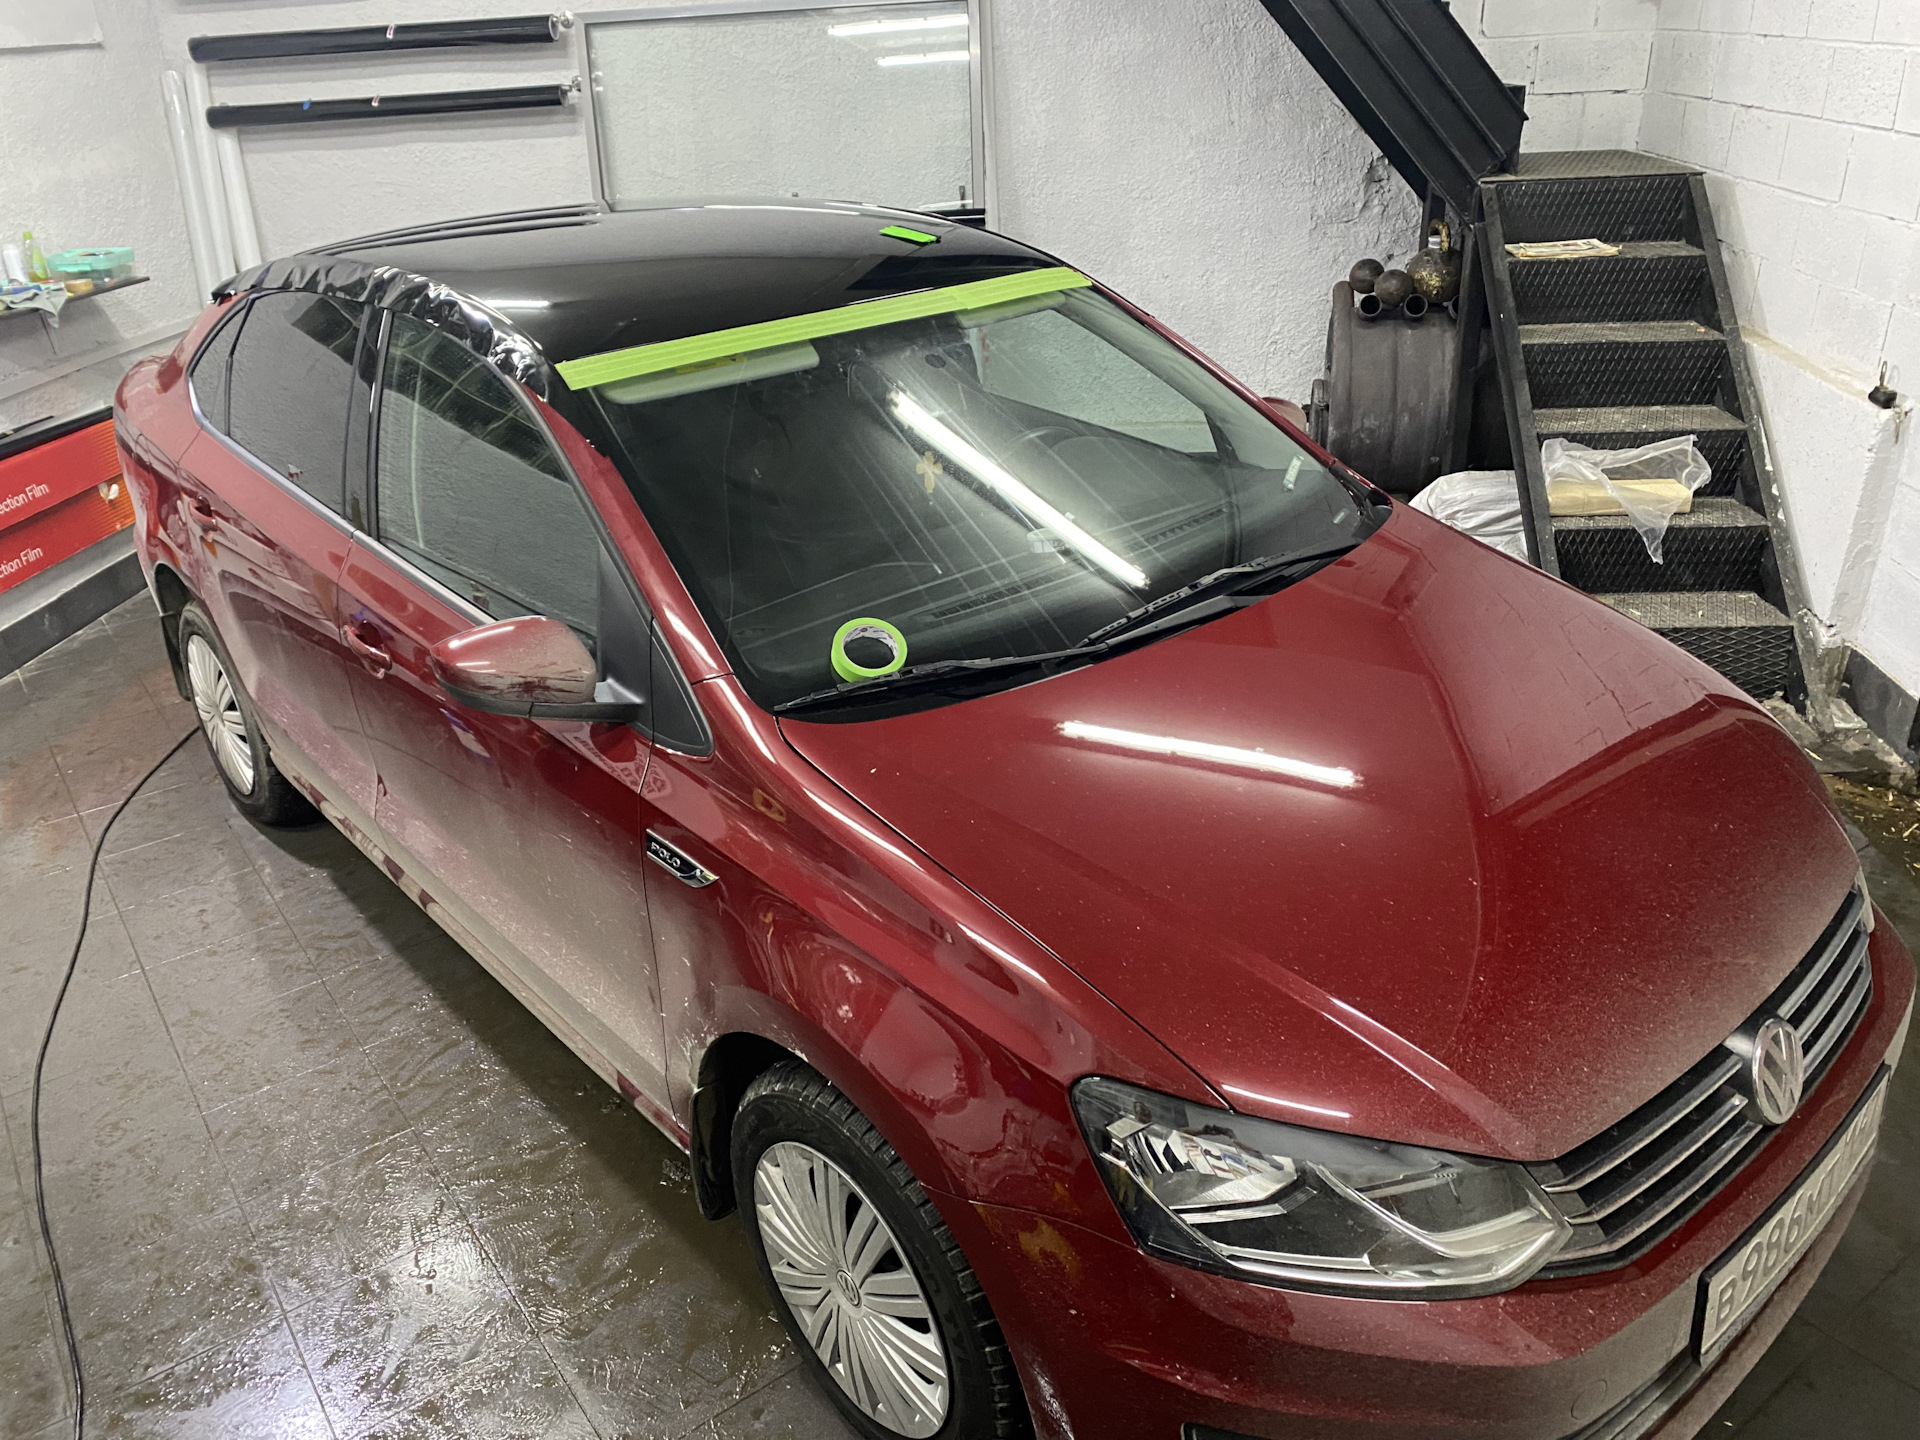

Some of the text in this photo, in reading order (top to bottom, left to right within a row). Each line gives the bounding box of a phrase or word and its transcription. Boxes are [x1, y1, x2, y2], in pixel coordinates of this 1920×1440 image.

[25, 483, 49, 500] Film
[20, 547, 43, 565] Film
[651, 842, 680, 868] POLO
